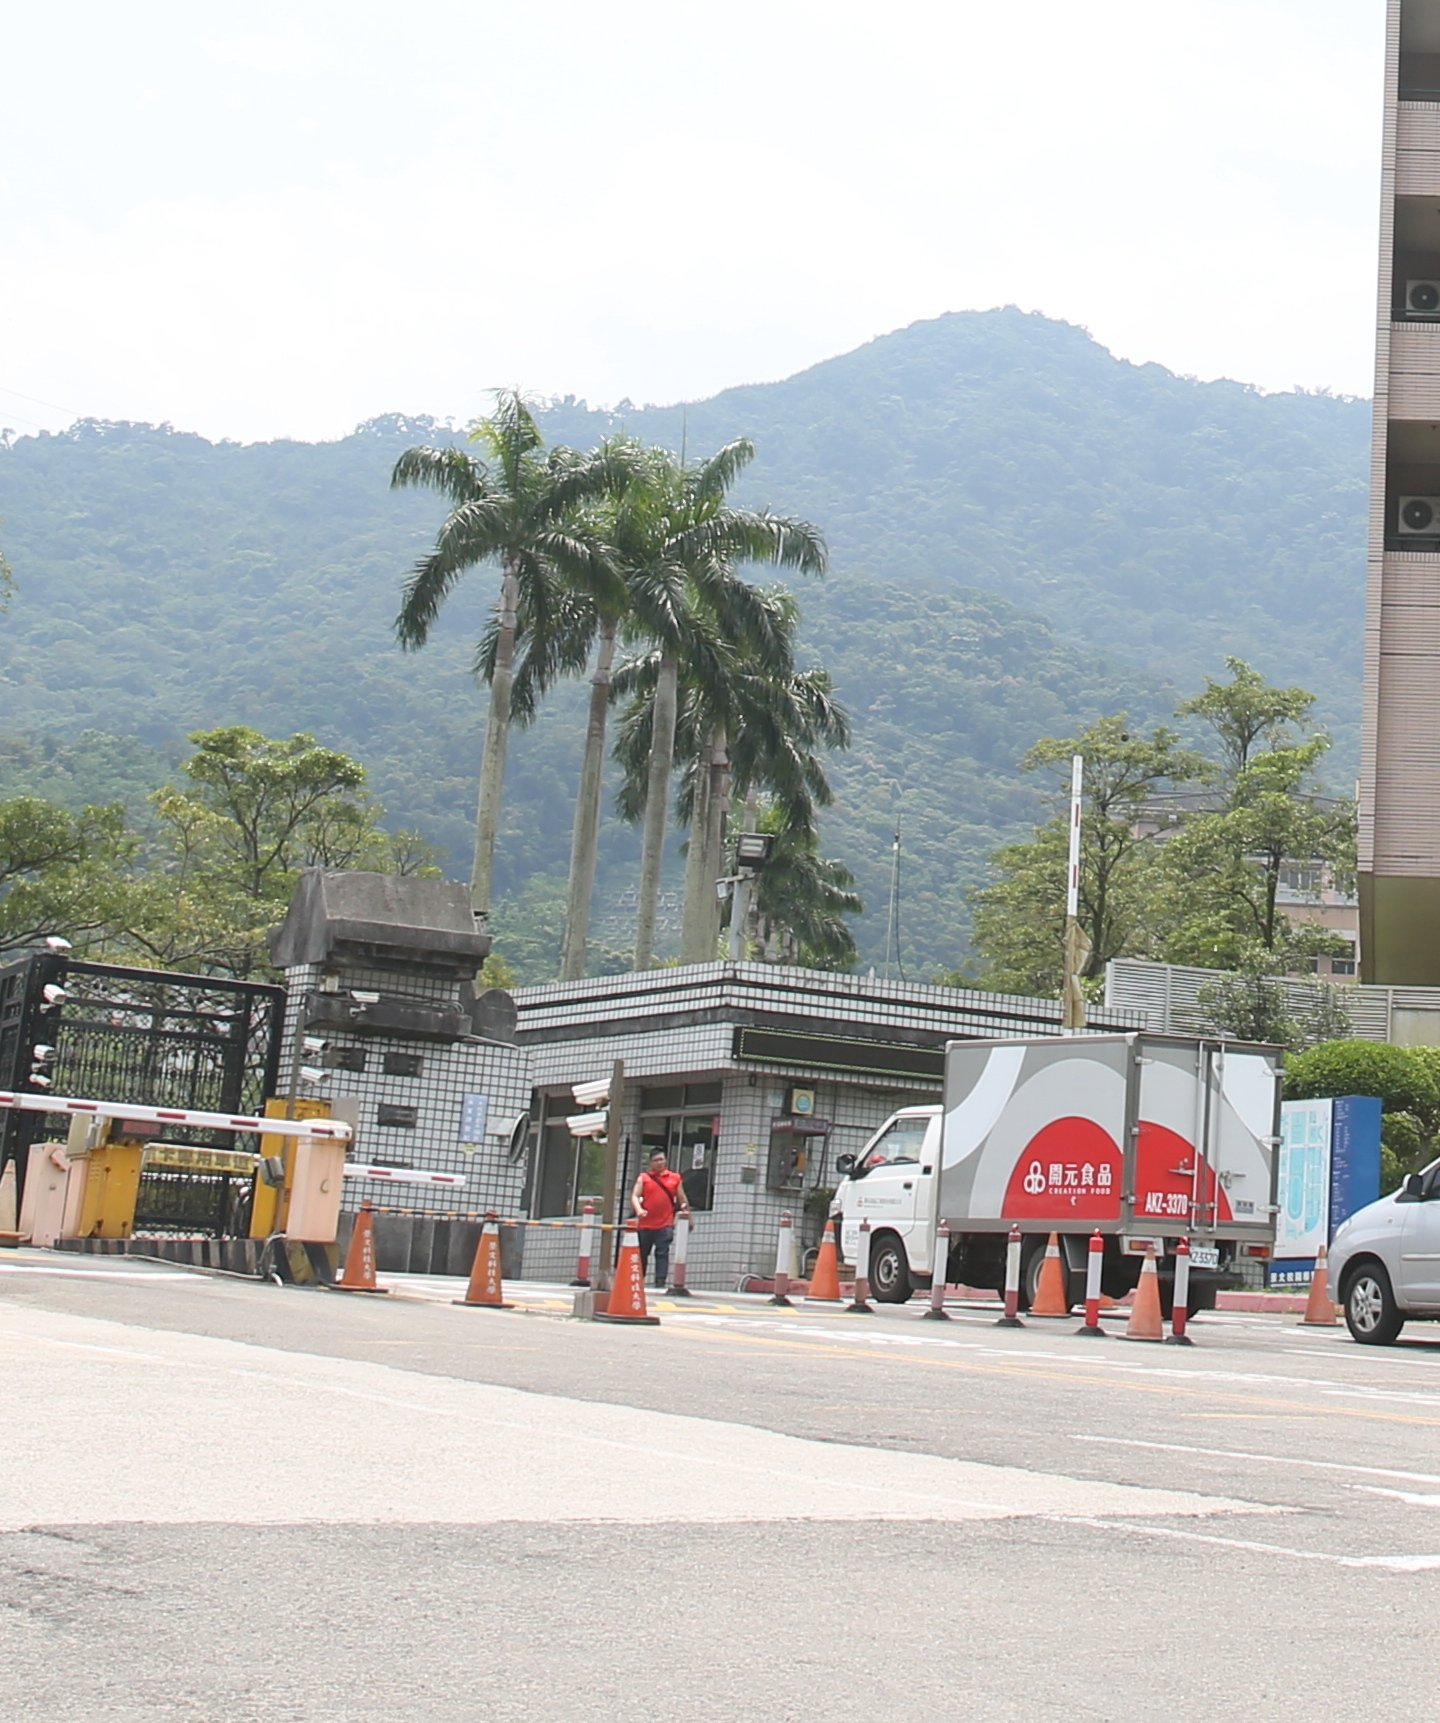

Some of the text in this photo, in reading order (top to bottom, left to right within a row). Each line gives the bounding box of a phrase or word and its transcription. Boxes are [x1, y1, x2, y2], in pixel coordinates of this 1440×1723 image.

[1049, 1162, 1112, 1186] 開元食品
[1145, 1192, 1188, 1215] AKZ-3370
